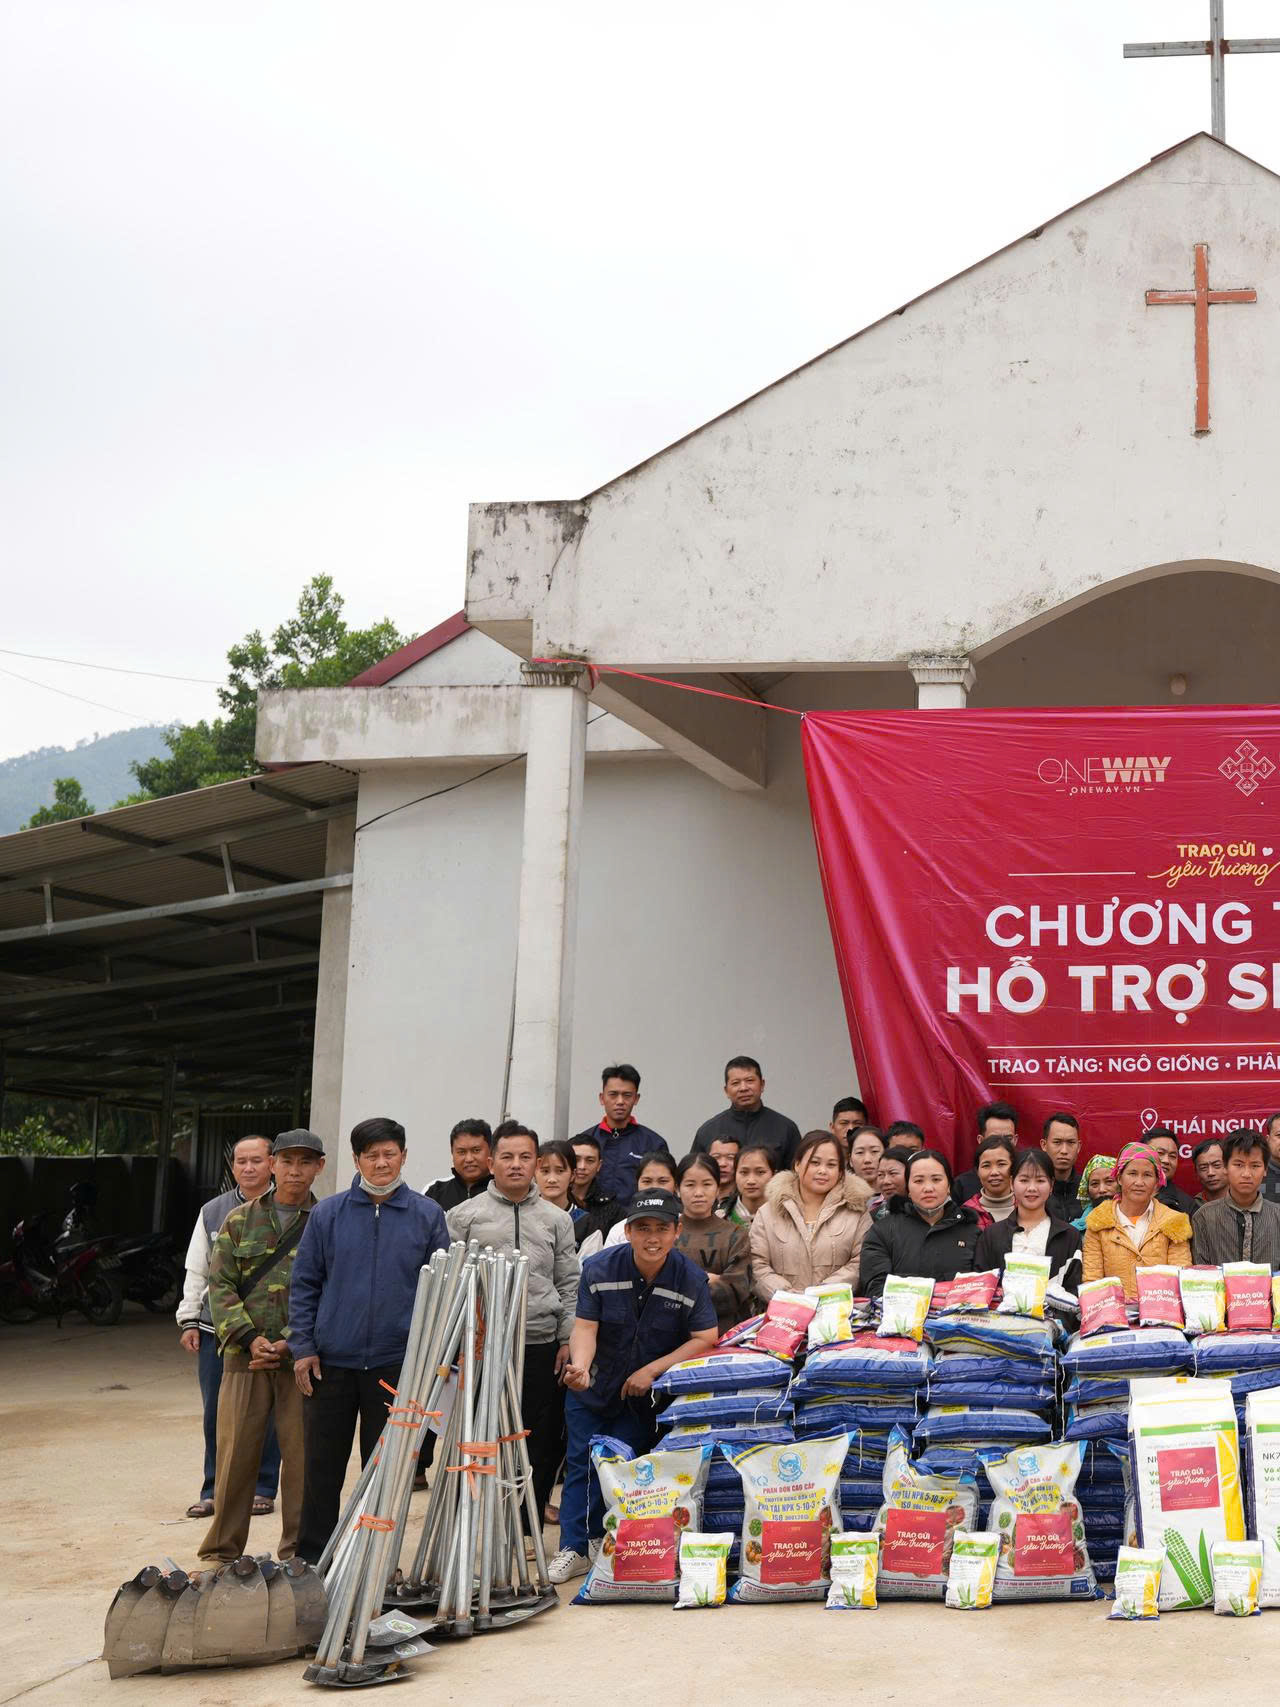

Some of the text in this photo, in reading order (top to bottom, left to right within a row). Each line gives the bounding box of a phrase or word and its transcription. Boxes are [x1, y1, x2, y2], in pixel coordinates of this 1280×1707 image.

[1037, 756, 1172, 784] ONEWAY
[1071, 785, 1141, 795] ONEWAY.VN
[1177, 839, 1256, 858] TRAO GỬI
[1150, 860, 1207, 888] yêu
[985, 896, 1252, 947] CHƯƠNG
[947, 955, 1047, 1014] HỖ
[1068, 958, 1208, 1024] TRỢ
[988, 1059, 1040, 1075] TRAO
[1045, 1056, 1103, 1077] TẶNG:
[1108, 1052, 1151, 1073] NGÔ
[1155, 1050, 1220, 1073] GIỐNG
[1162, 1115, 1205, 1134] THÁI
[637, 1198, 664, 1207] ONEWAY
[897, 1531, 917, 1539] TRAO
[773, 1542, 794, 1550] TRAO
